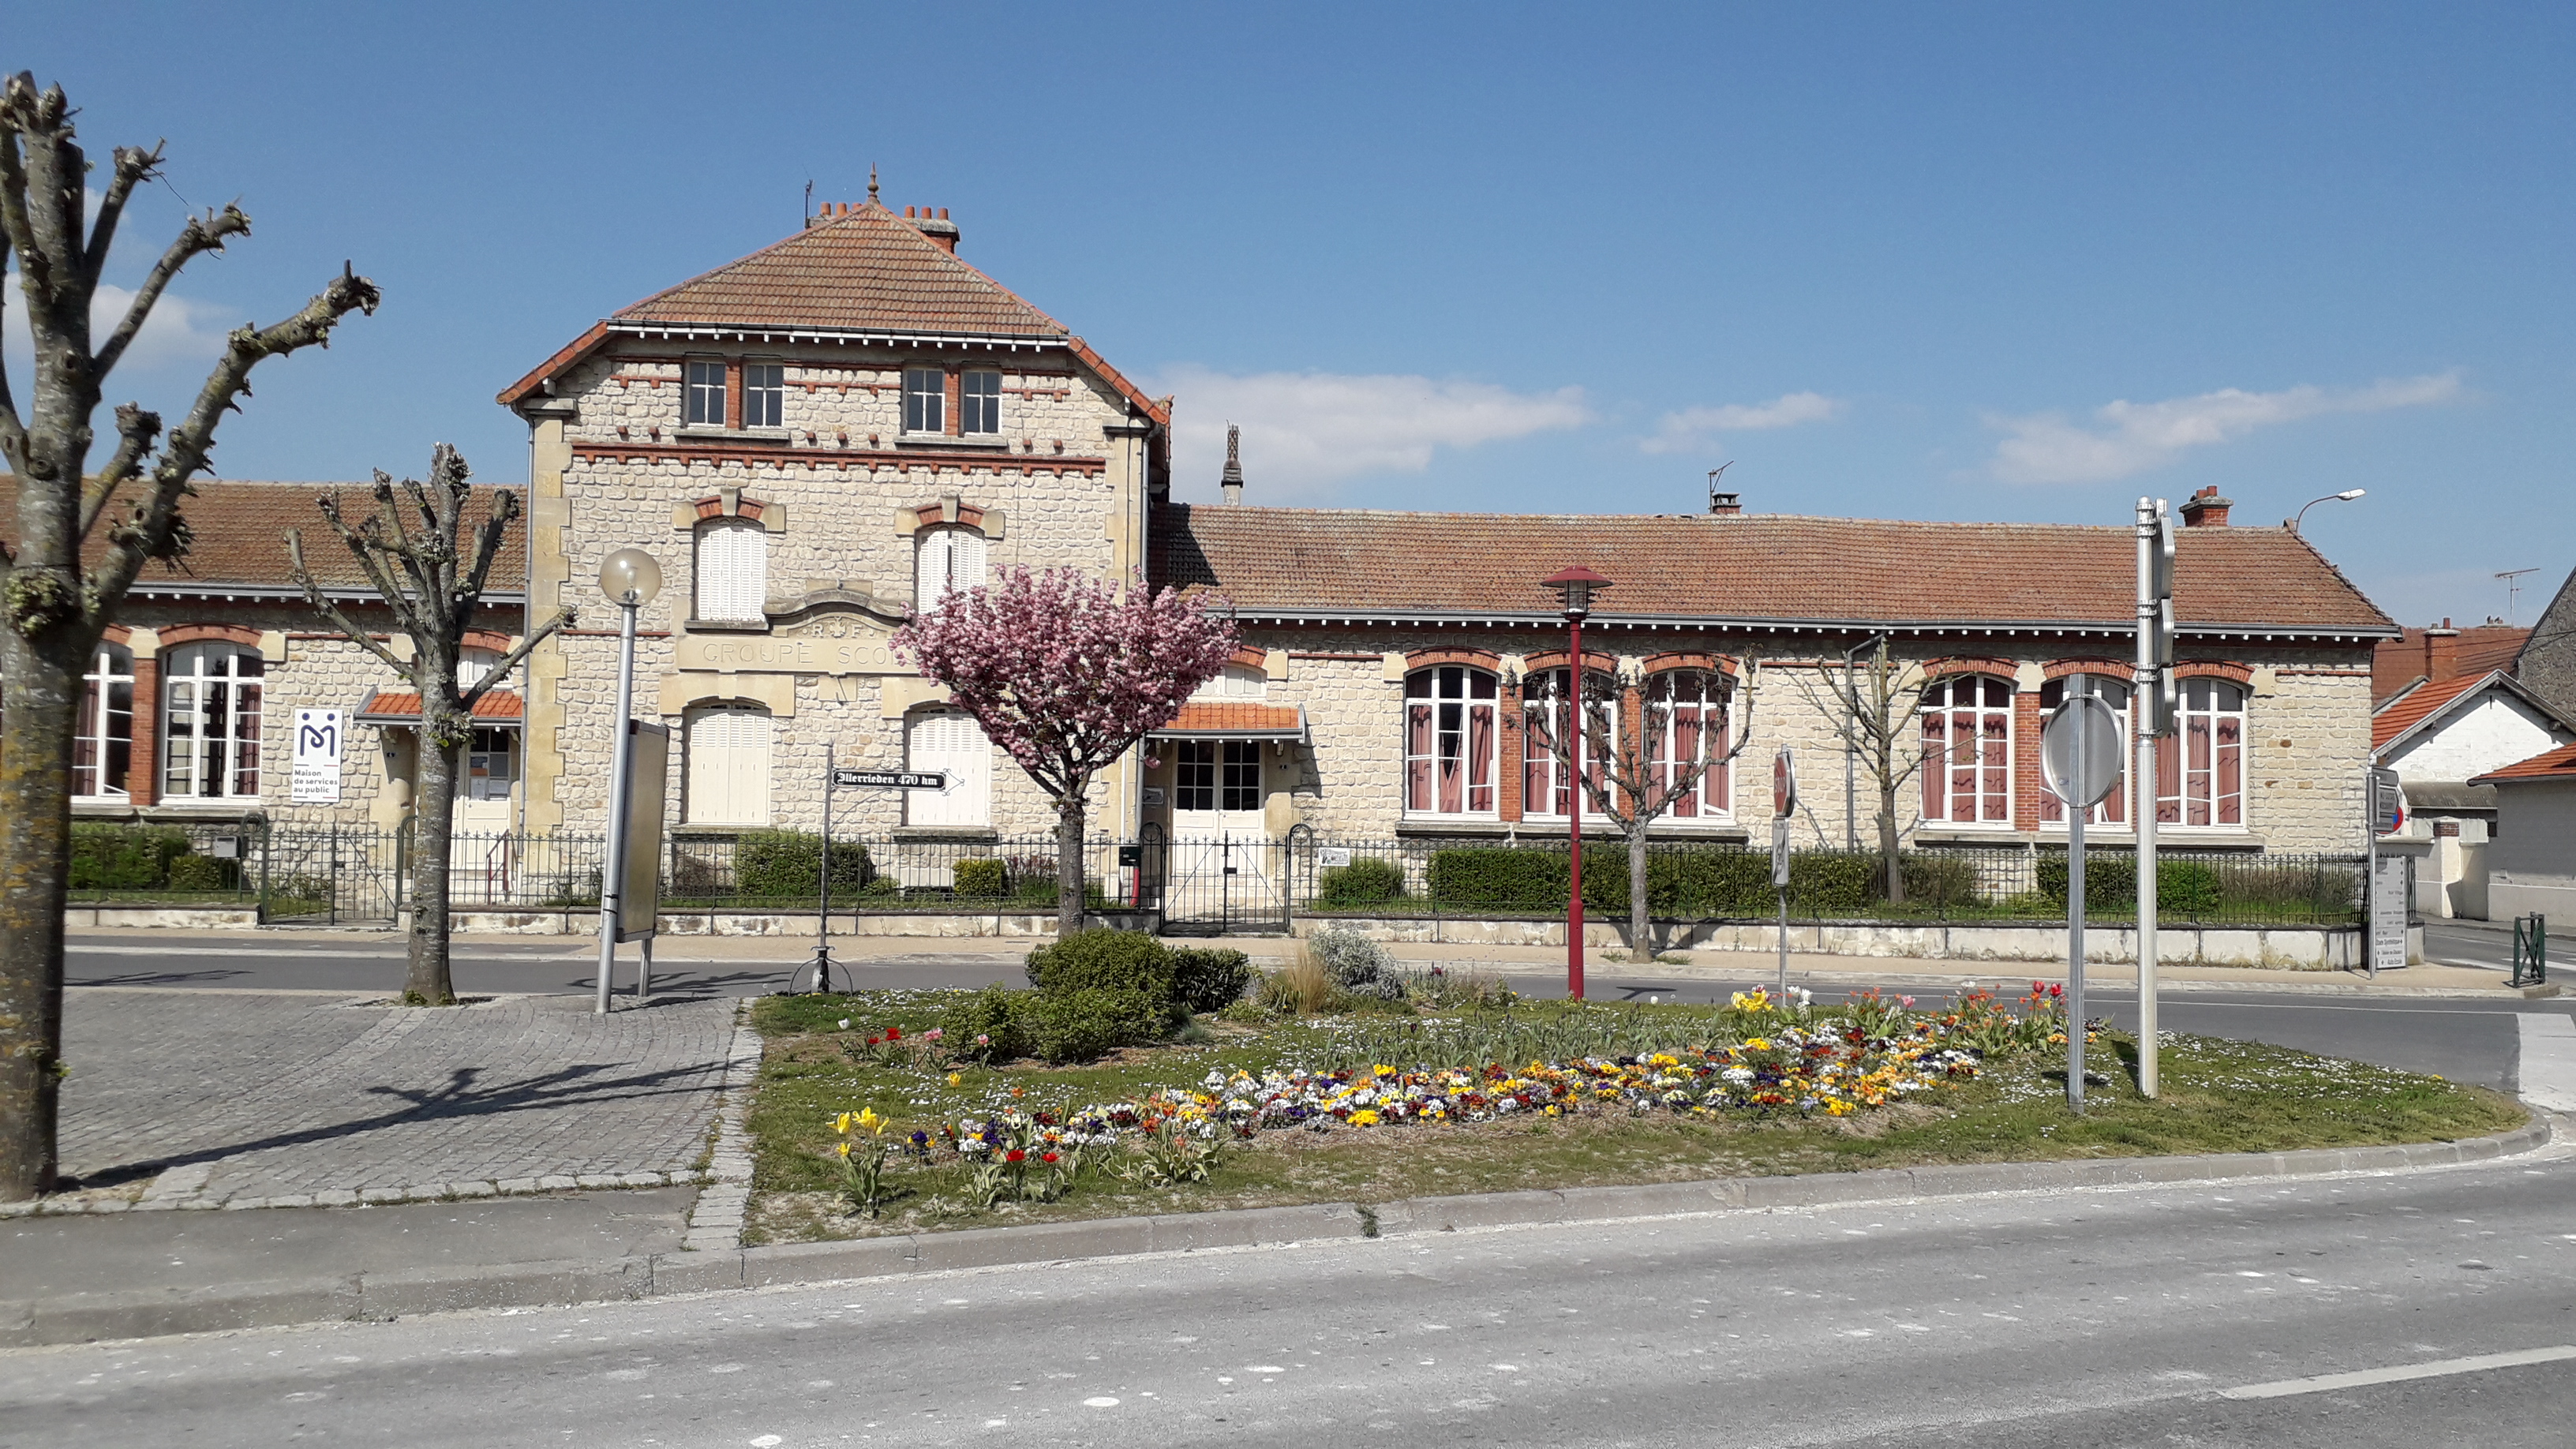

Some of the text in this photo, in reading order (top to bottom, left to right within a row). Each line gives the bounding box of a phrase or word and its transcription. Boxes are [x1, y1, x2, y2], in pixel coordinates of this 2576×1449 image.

[812, 623, 862, 638] R F
[702, 642, 903, 665] GROUPE SCOL
[837, 772, 938, 786] Illerrieden 470 km
